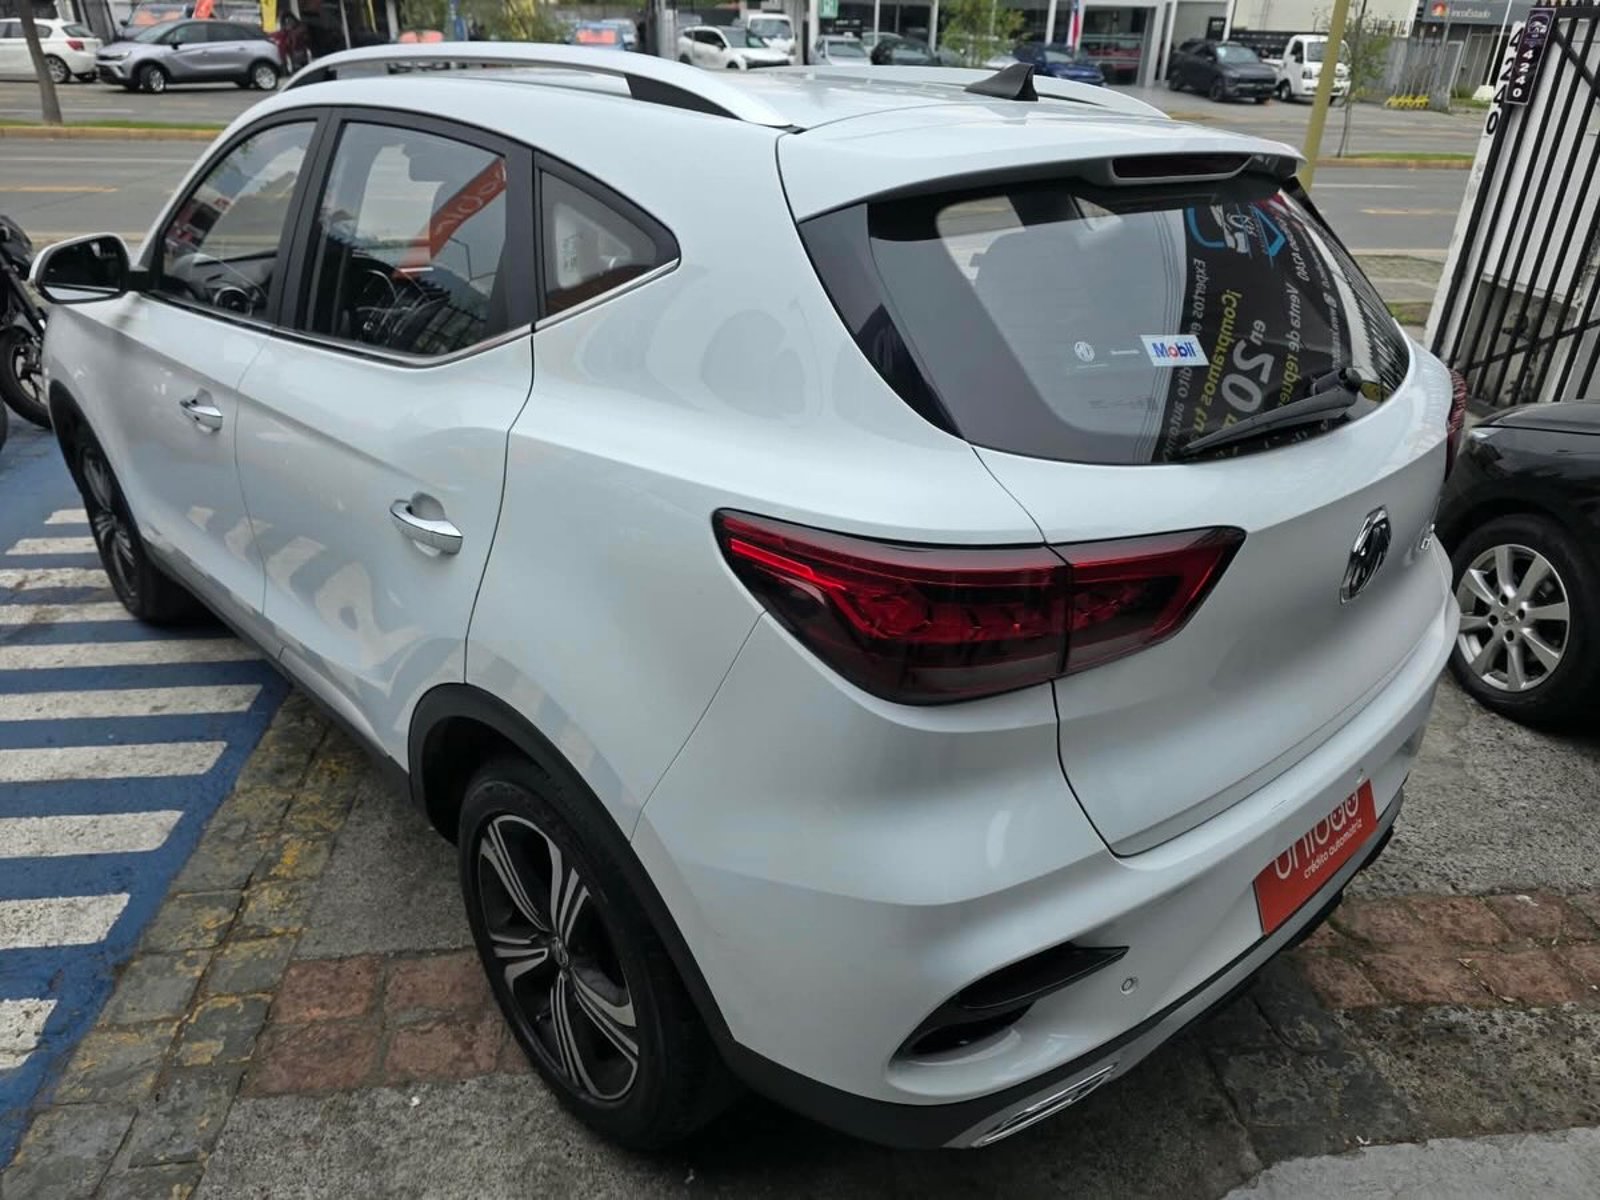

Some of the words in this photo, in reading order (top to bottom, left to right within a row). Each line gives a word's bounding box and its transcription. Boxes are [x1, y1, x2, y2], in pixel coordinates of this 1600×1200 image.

[1512, 50, 1534, 98] 4240
[1152, 342, 1196, 358] Mobil
[1303, 852, 1329, 879] crédito
[1328, 818, 1363, 856] automotriz
